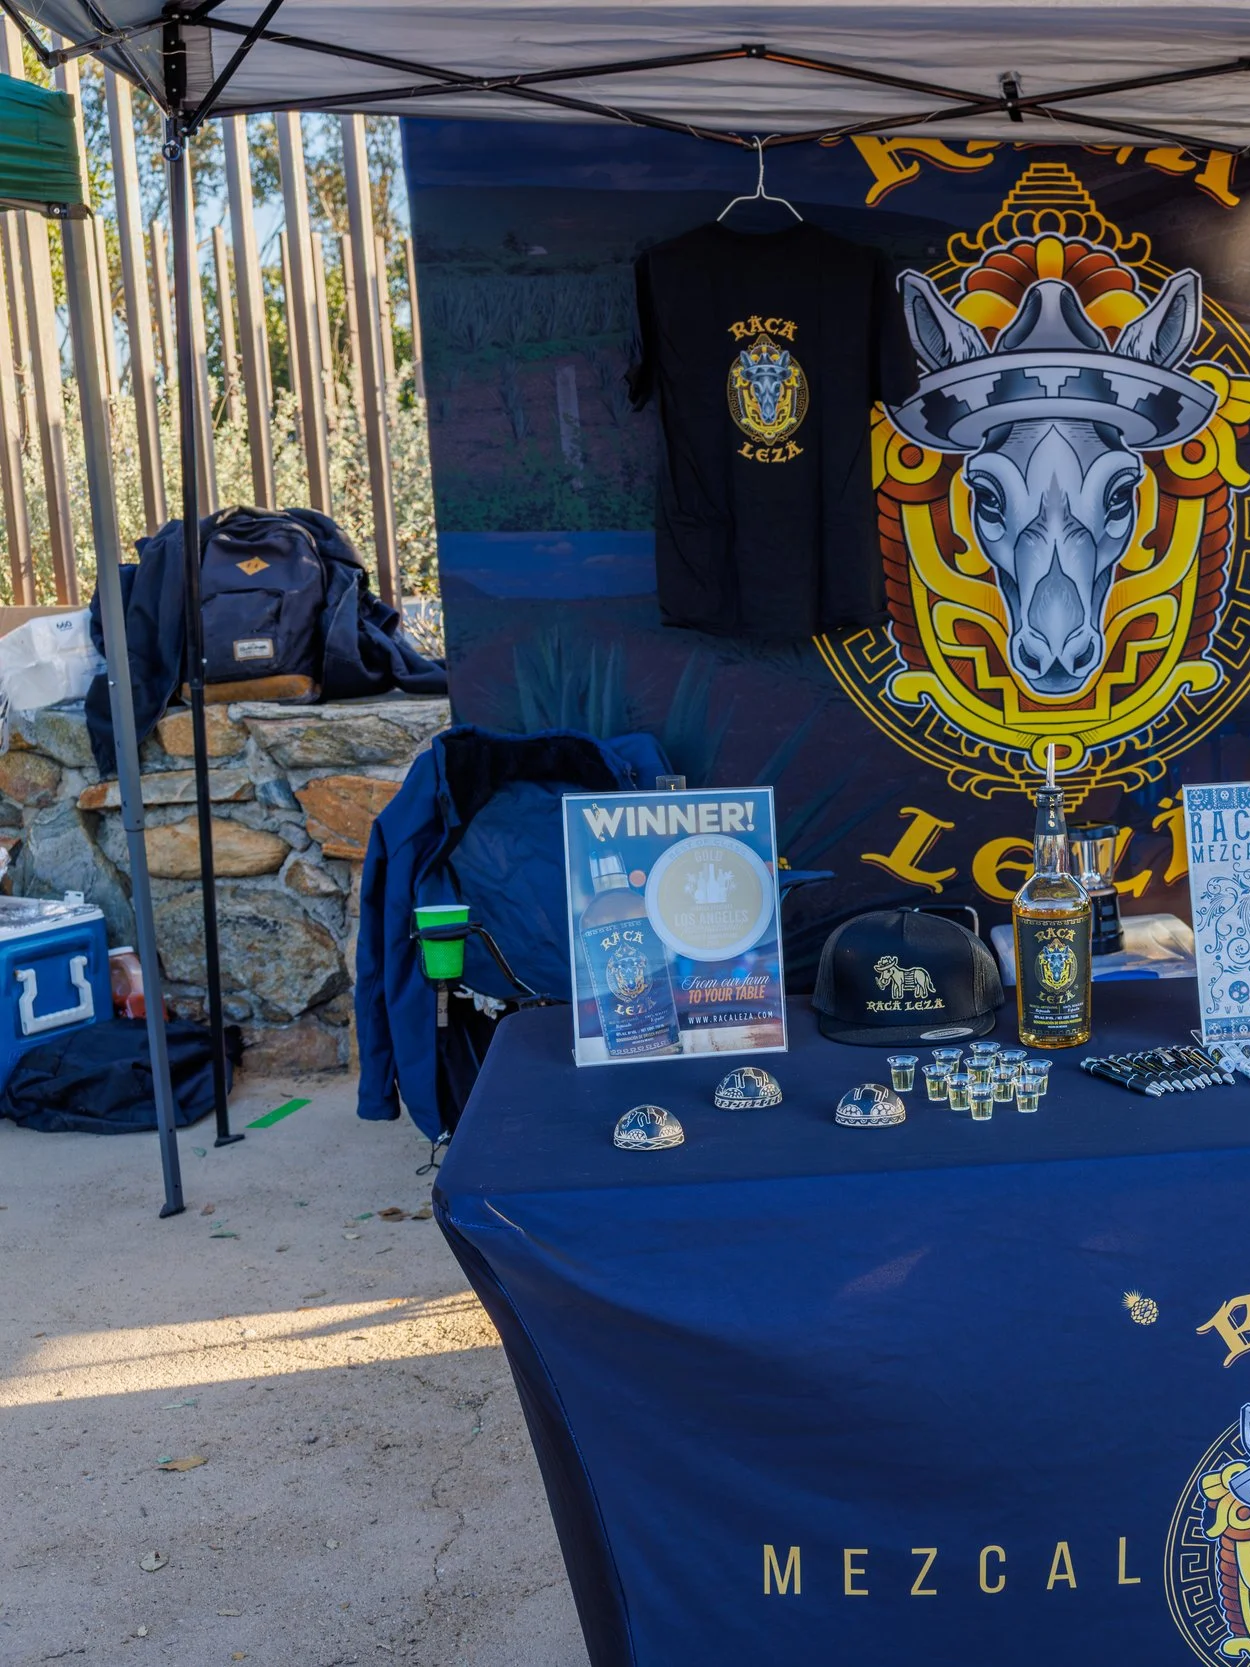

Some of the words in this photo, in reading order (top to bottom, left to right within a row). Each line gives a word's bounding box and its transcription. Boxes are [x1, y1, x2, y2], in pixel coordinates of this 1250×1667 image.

[727, 315, 798, 342] RÄCÄ
[737, 440, 804, 463] LEZÄ
[582, 801, 755, 840] WINNER!
[694, 849, 724, 863] GOLD
[674, 912, 696, 927] LOS
[699, 909, 749, 925] ANGELES
[681, 975, 719, 992] From
[739, 971, 771, 988] farm
[689, 989, 703, 1004] TO
[704, 986, 733, 1003] YOUR
[735, 984, 767, 1001] TABLE
[688, 1010, 774, 1026] WWW.RACALEZA.COM
[763, 1536, 1142, 1596] MEZCAL
